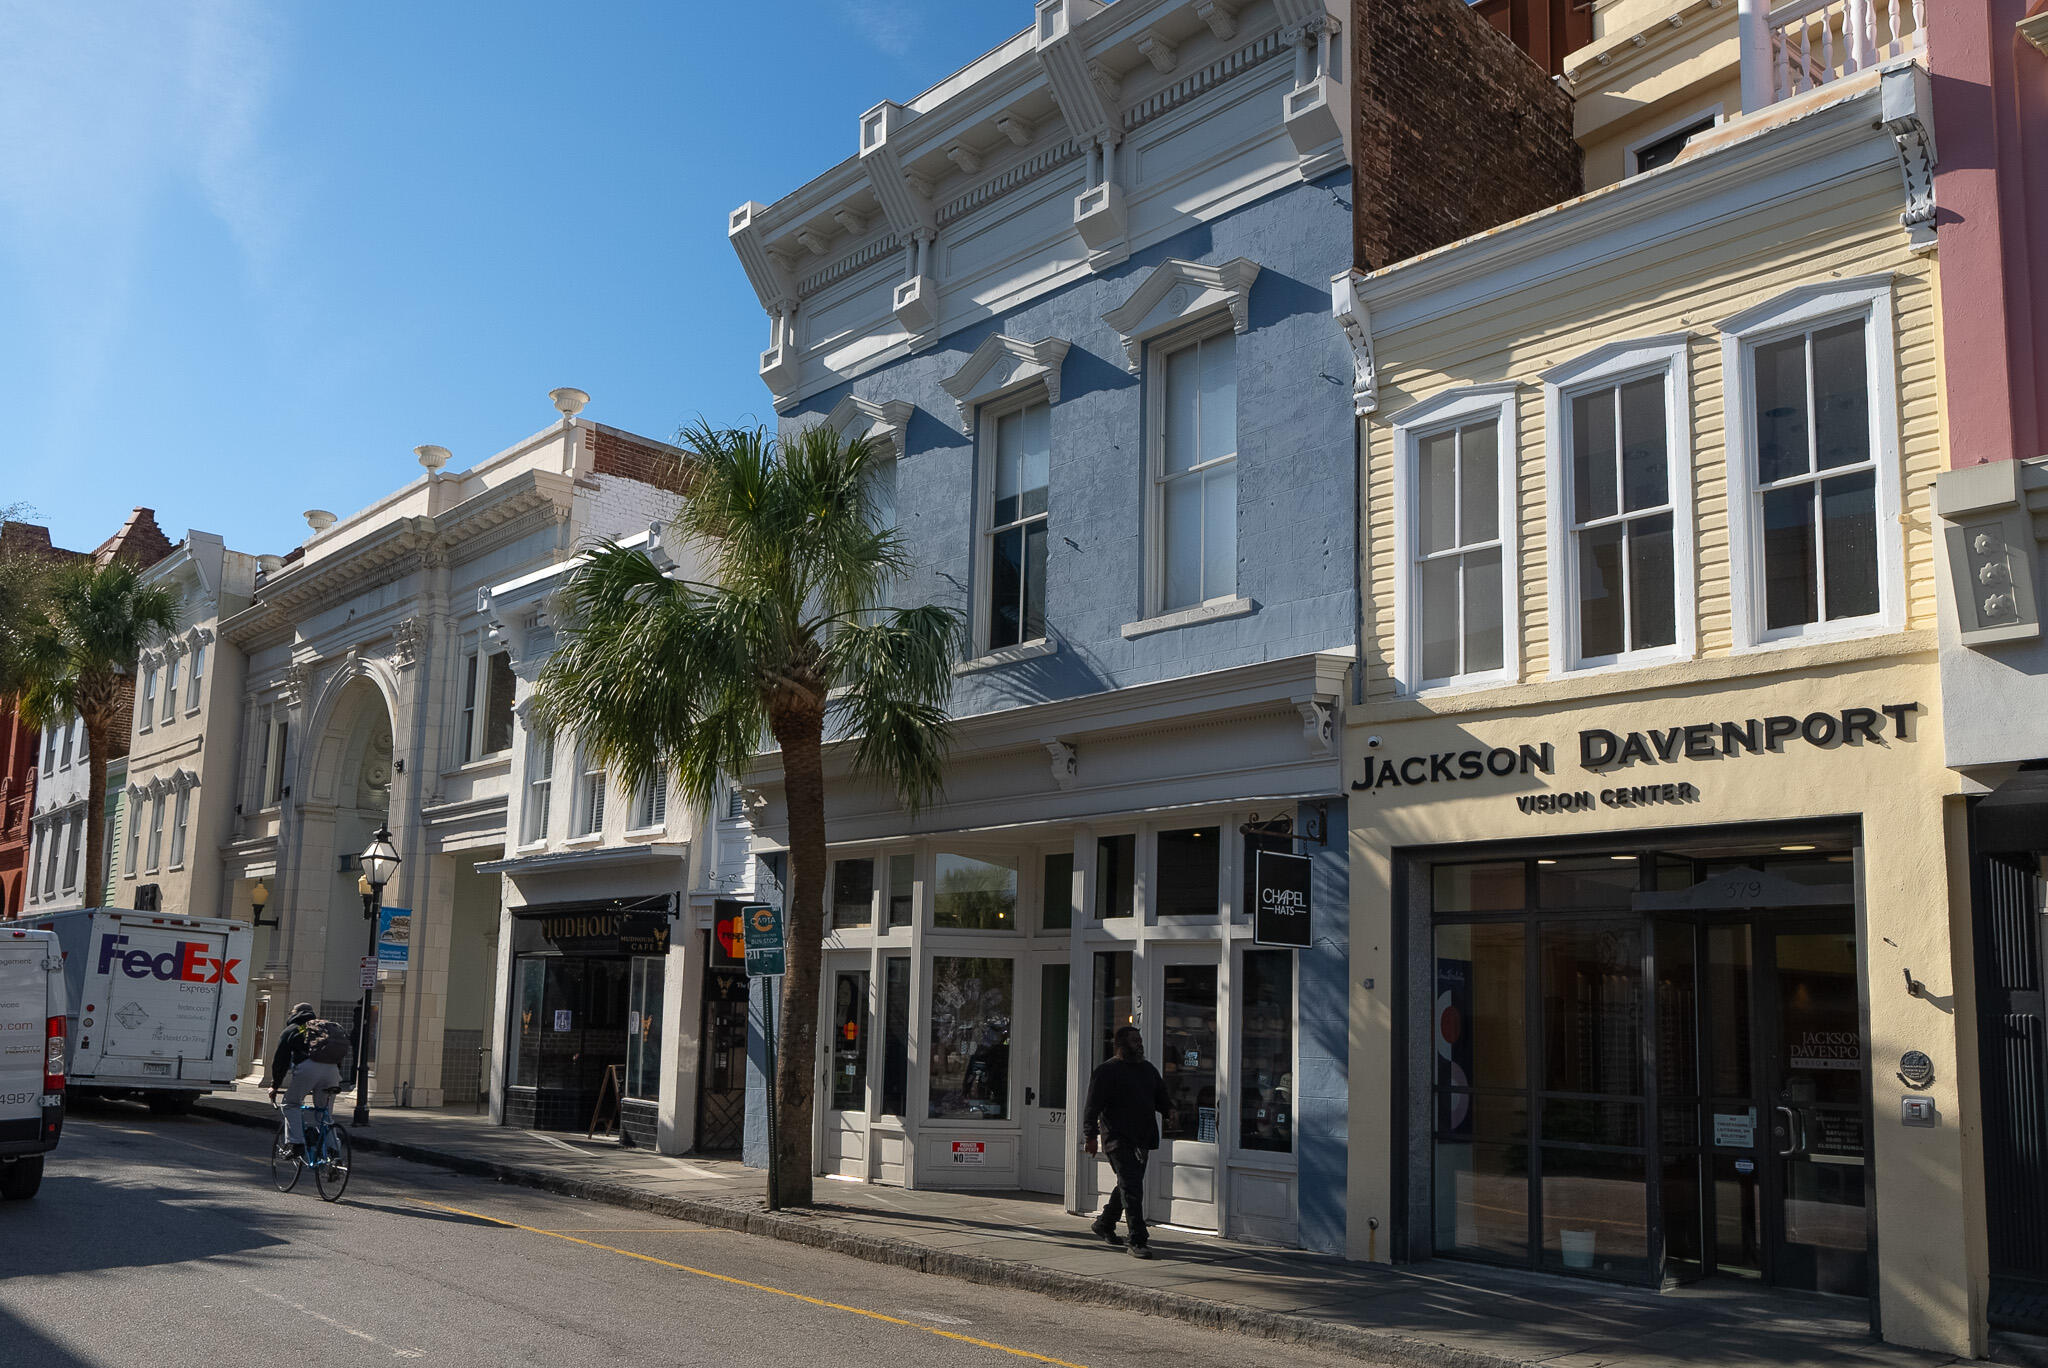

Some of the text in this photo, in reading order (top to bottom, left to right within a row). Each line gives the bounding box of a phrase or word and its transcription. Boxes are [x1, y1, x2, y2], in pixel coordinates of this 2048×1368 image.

[1351, 701, 1918, 790] JACKSON DAVENPORT
[1516, 782, 1692, 812] VISION CENTER
[1262, 888, 1306, 907] CHAPEL
[1727, 881, 1761, 899] 379
[1274, 905, 1295, 916] HATS
[541, 914, 630, 938] MUDHOUS
[97, 933, 243, 984] FedEx
[747, 950, 760, 960] 211
[179, 983, 217, 994] Express
[1803, 1031, 1860, 1046] JACKSON
[953, 1153, 964, 1163] NO
